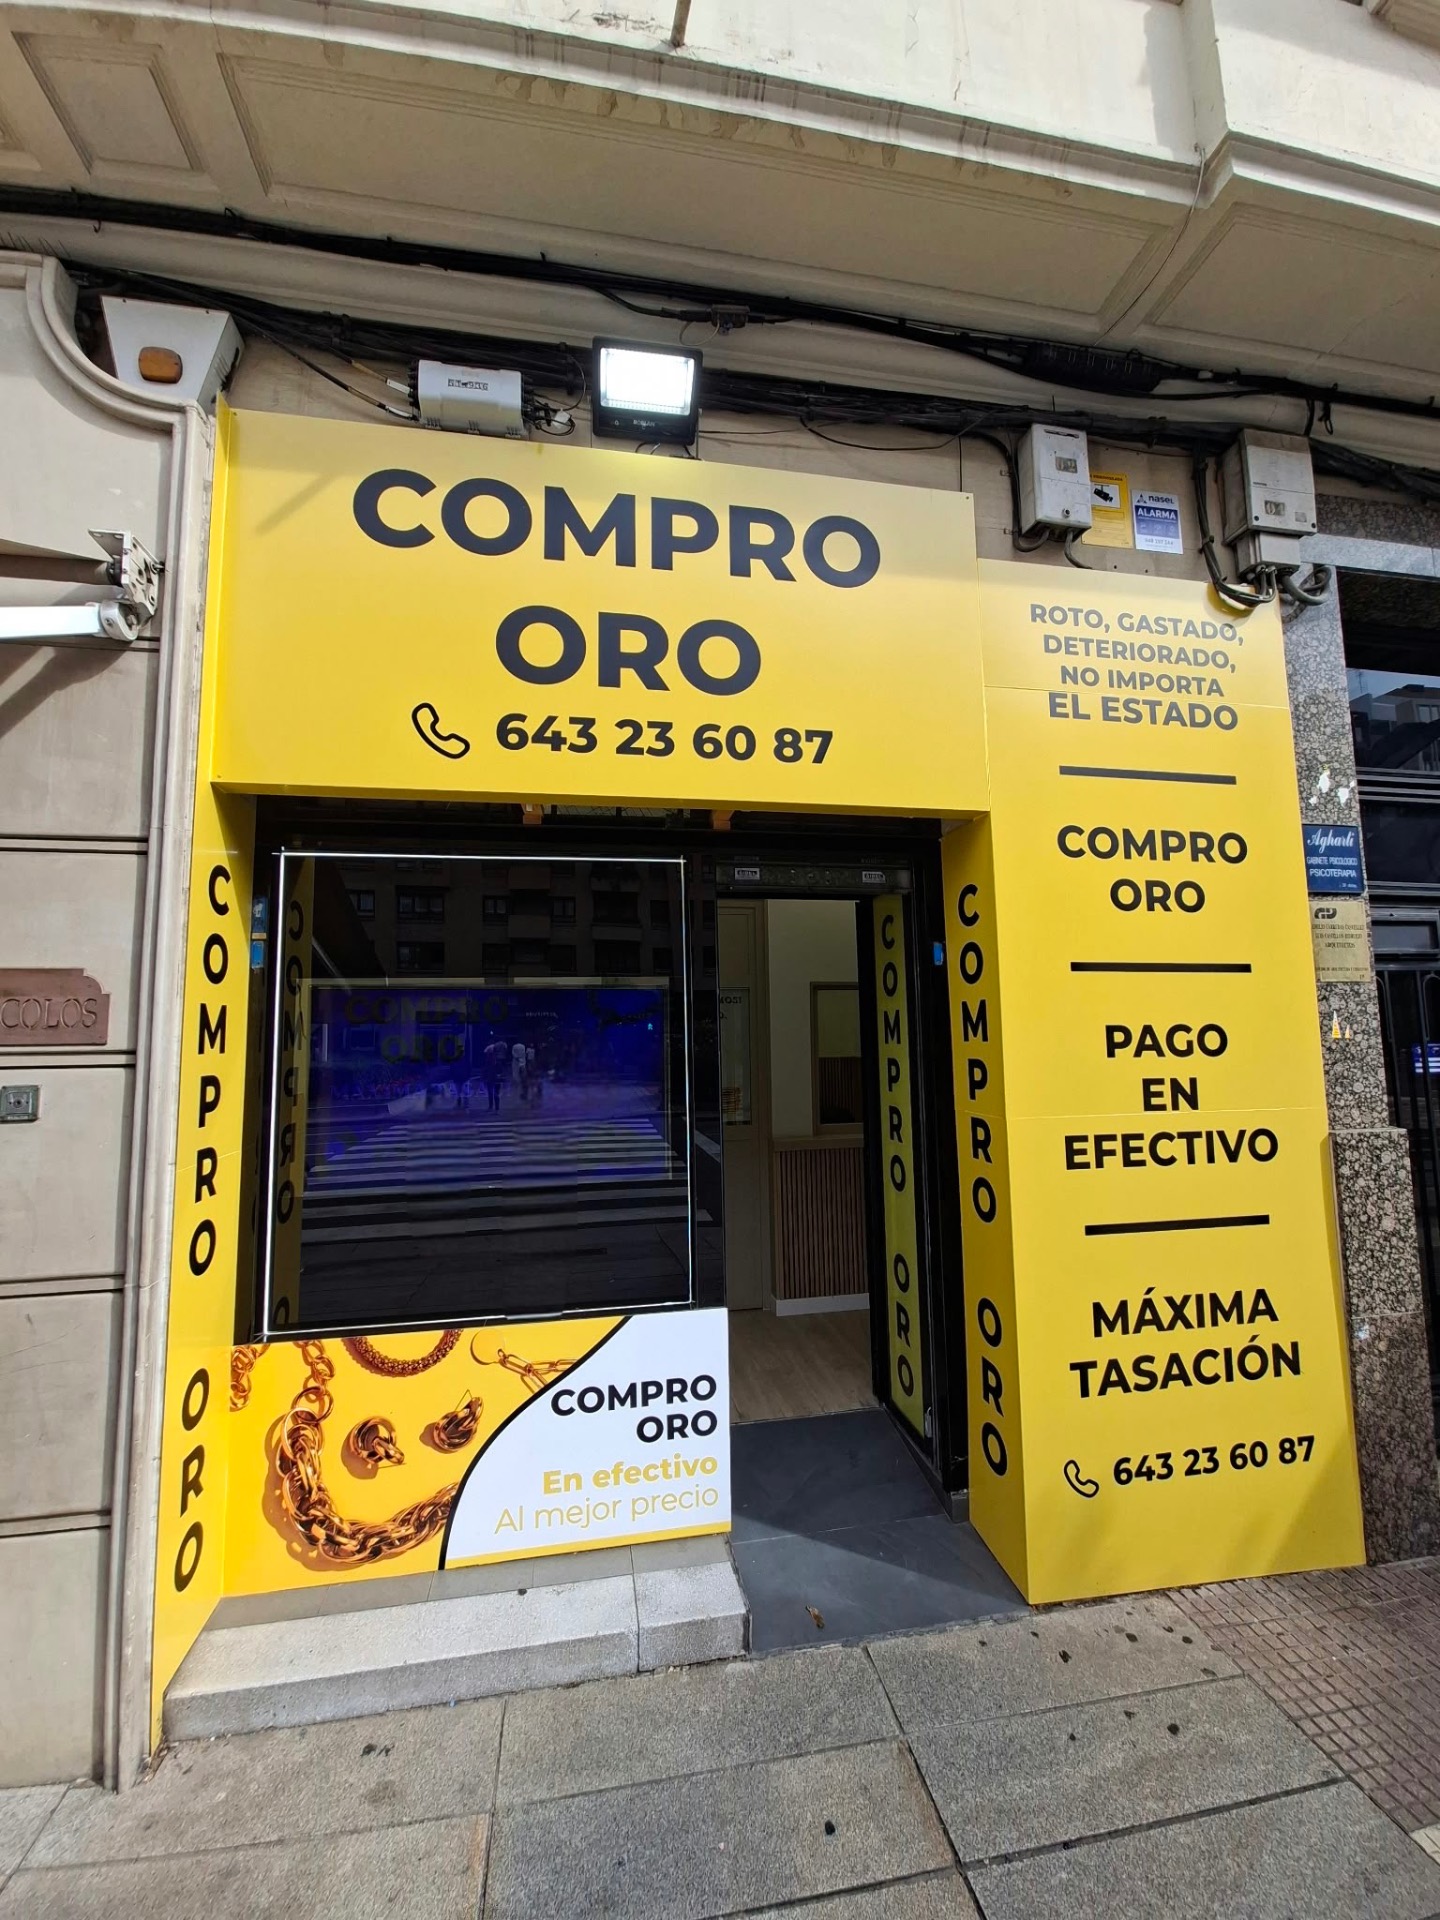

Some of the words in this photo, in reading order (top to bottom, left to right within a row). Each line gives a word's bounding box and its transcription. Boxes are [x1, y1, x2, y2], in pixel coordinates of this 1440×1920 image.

[353, 469, 881, 588] COMPRO
[1138, 507, 1176, 520] ALARMA
[1031, 603, 1110, 634] ROTO,
[1118, 612, 1244, 645] GASTADO,
[496, 606, 761, 695] ORO
[1043, 635, 1237, 673] DETERIORADO,
[1061, 666, 1099, 686] NO
[1108, 668, 1224, 698] IMPORTA
[1049, 691, 1090, 720] EL
[1102, 697, 1238, 730] ESTADO
[497, 713, 597, 753] 643
[615, 719, 674, 756] 23
[693, 724, 757, 760] 60
[774, 728, 833, 763] 87
[1058, 825, 1247, 864] COMPRO
[1309, 868, 1357, 878] PSICOTERAPIA
[1110, 879, 1205, 913] ORO
[1106, 1024, 1227, 1058] PAGO
[188, 864, 231, 1277] COMPRO
[1142, 1077, 1199, 1111] EN
[881, 914, 907, 1192] COMPRO
[894, 1253, 915, 1399] ORO
[1065, 1128, 1279, 1170] EFECTIVO
[956, 884, 997, 1224] COMPRO
[978, 1298, 1007, 1476] ORO
[1092, 1287, 1279, 1338] MÁXIMA
[1070, 1334, 1301, 1399] TASACIÓN
[551, 1374, 717, 1416] COMPRO
[636, 1410, 718, 1443] ORO
[174, 1367, 210, 1592] ORO
[543, 1470, 583, 1495] En
[592, 1453, 718, 1486] efectivo
[1113, 1453, 1174, 1485] 643
[1183, 1447, 1219, 1477] 23
[1229, 1441, 1268, 1470] 60
[1278, 1436, 1315, 1464] 87
[494, 1505, 524, 1535] Al
[535, 1497, 622, 1529] mejor
[632, 1484, 719, 1522] precio
